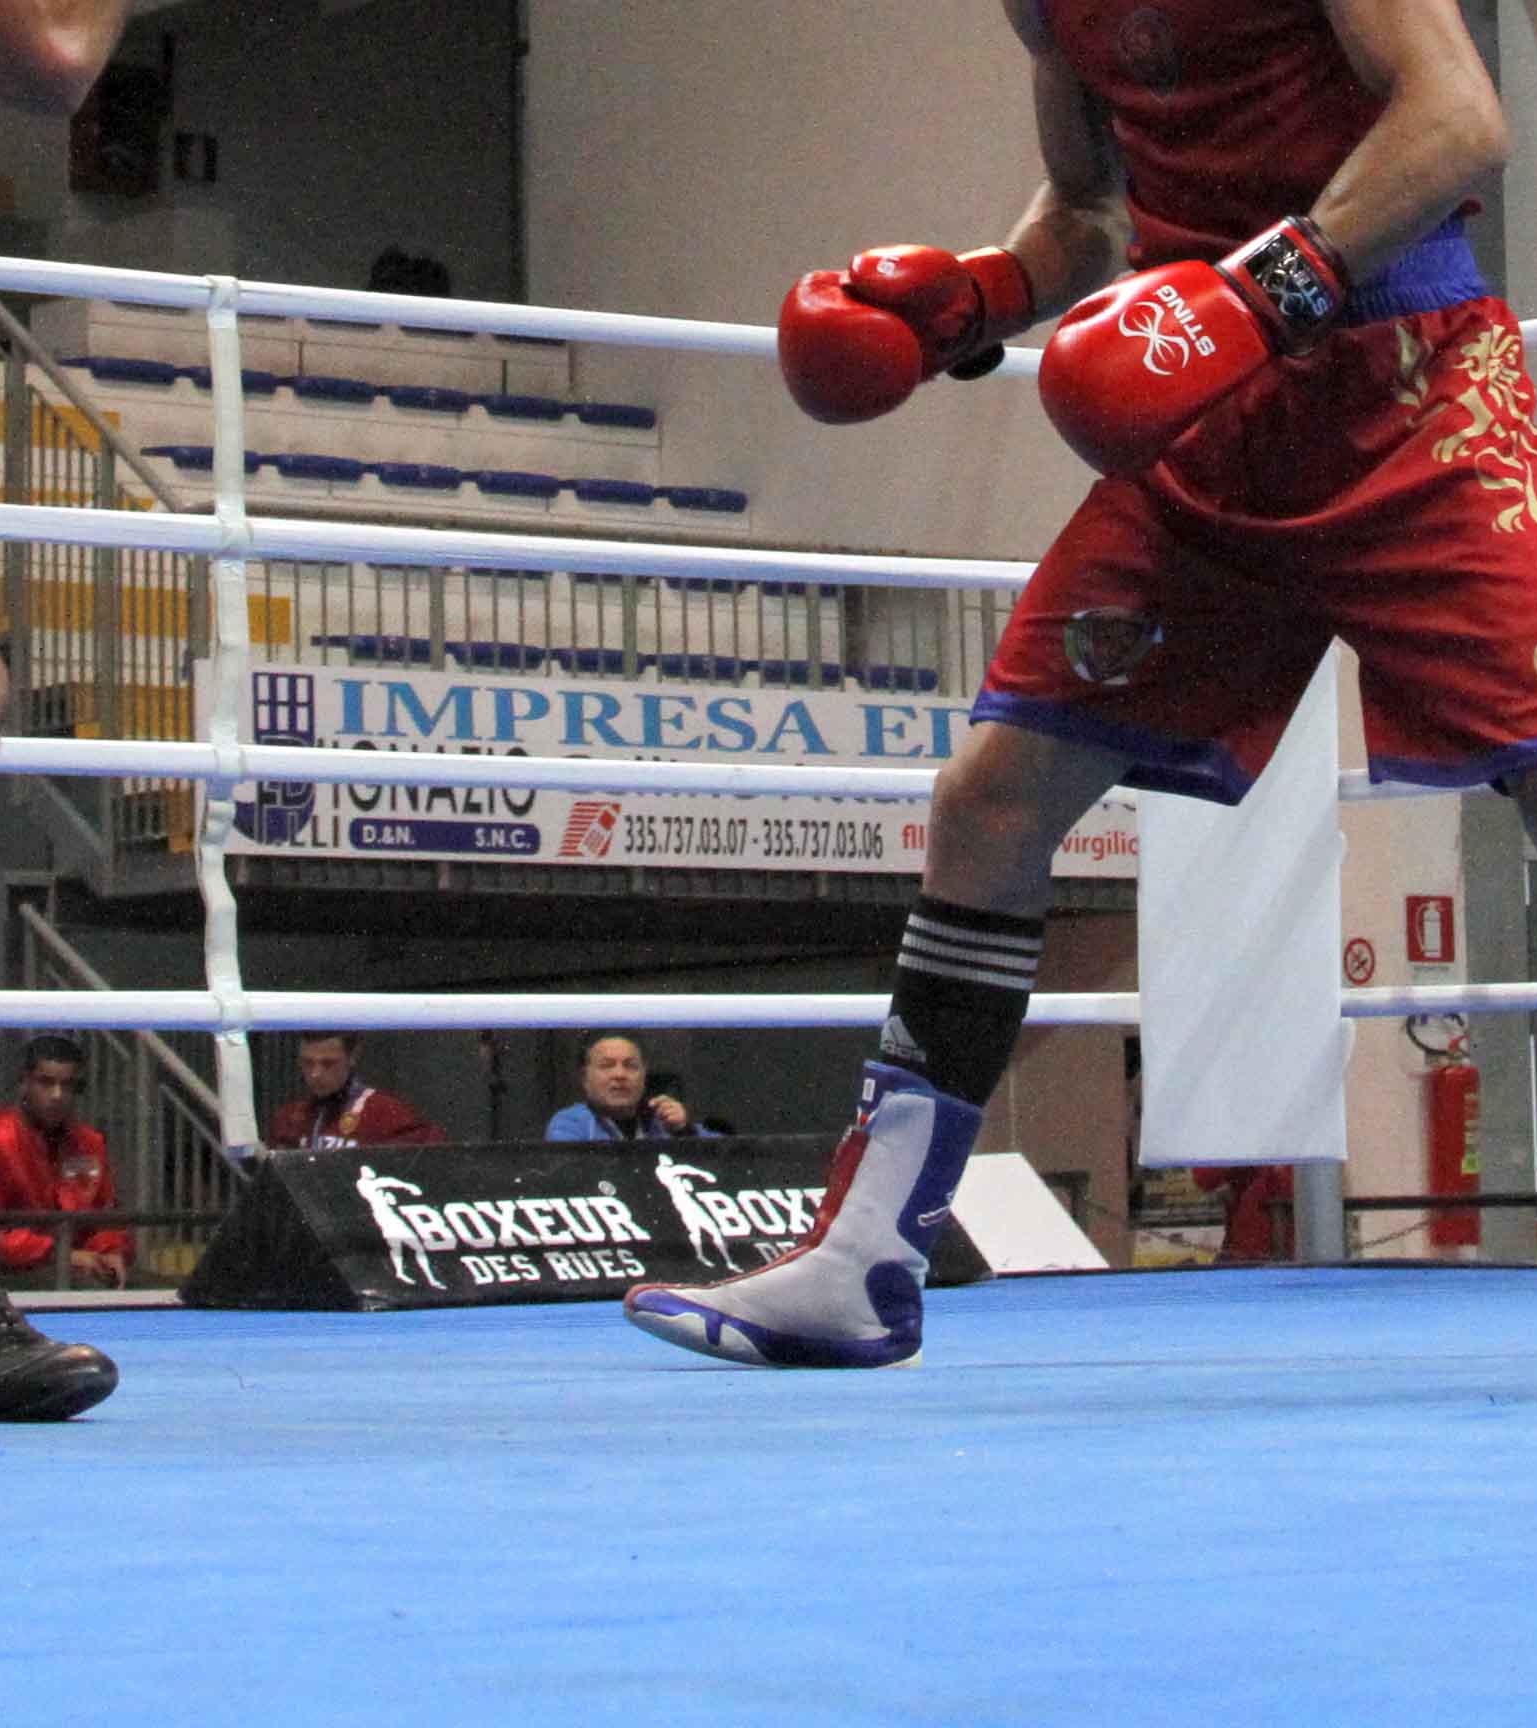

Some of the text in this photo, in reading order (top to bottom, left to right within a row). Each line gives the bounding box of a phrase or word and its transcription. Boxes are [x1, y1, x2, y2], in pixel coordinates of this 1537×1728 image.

[1153, 284, 1217, 359] STING
[334, 677, 836, 756] IMPRESA
[474, 828, 532, 850] S.N.C.
[623, 814, 748, 856] 335.737.03.07
[762, 818, 883, 860] 335.737.03.06
[398, 1197, 651, 1252] BOXEUR
[460, 1248, 647, 1285] DES RUES
